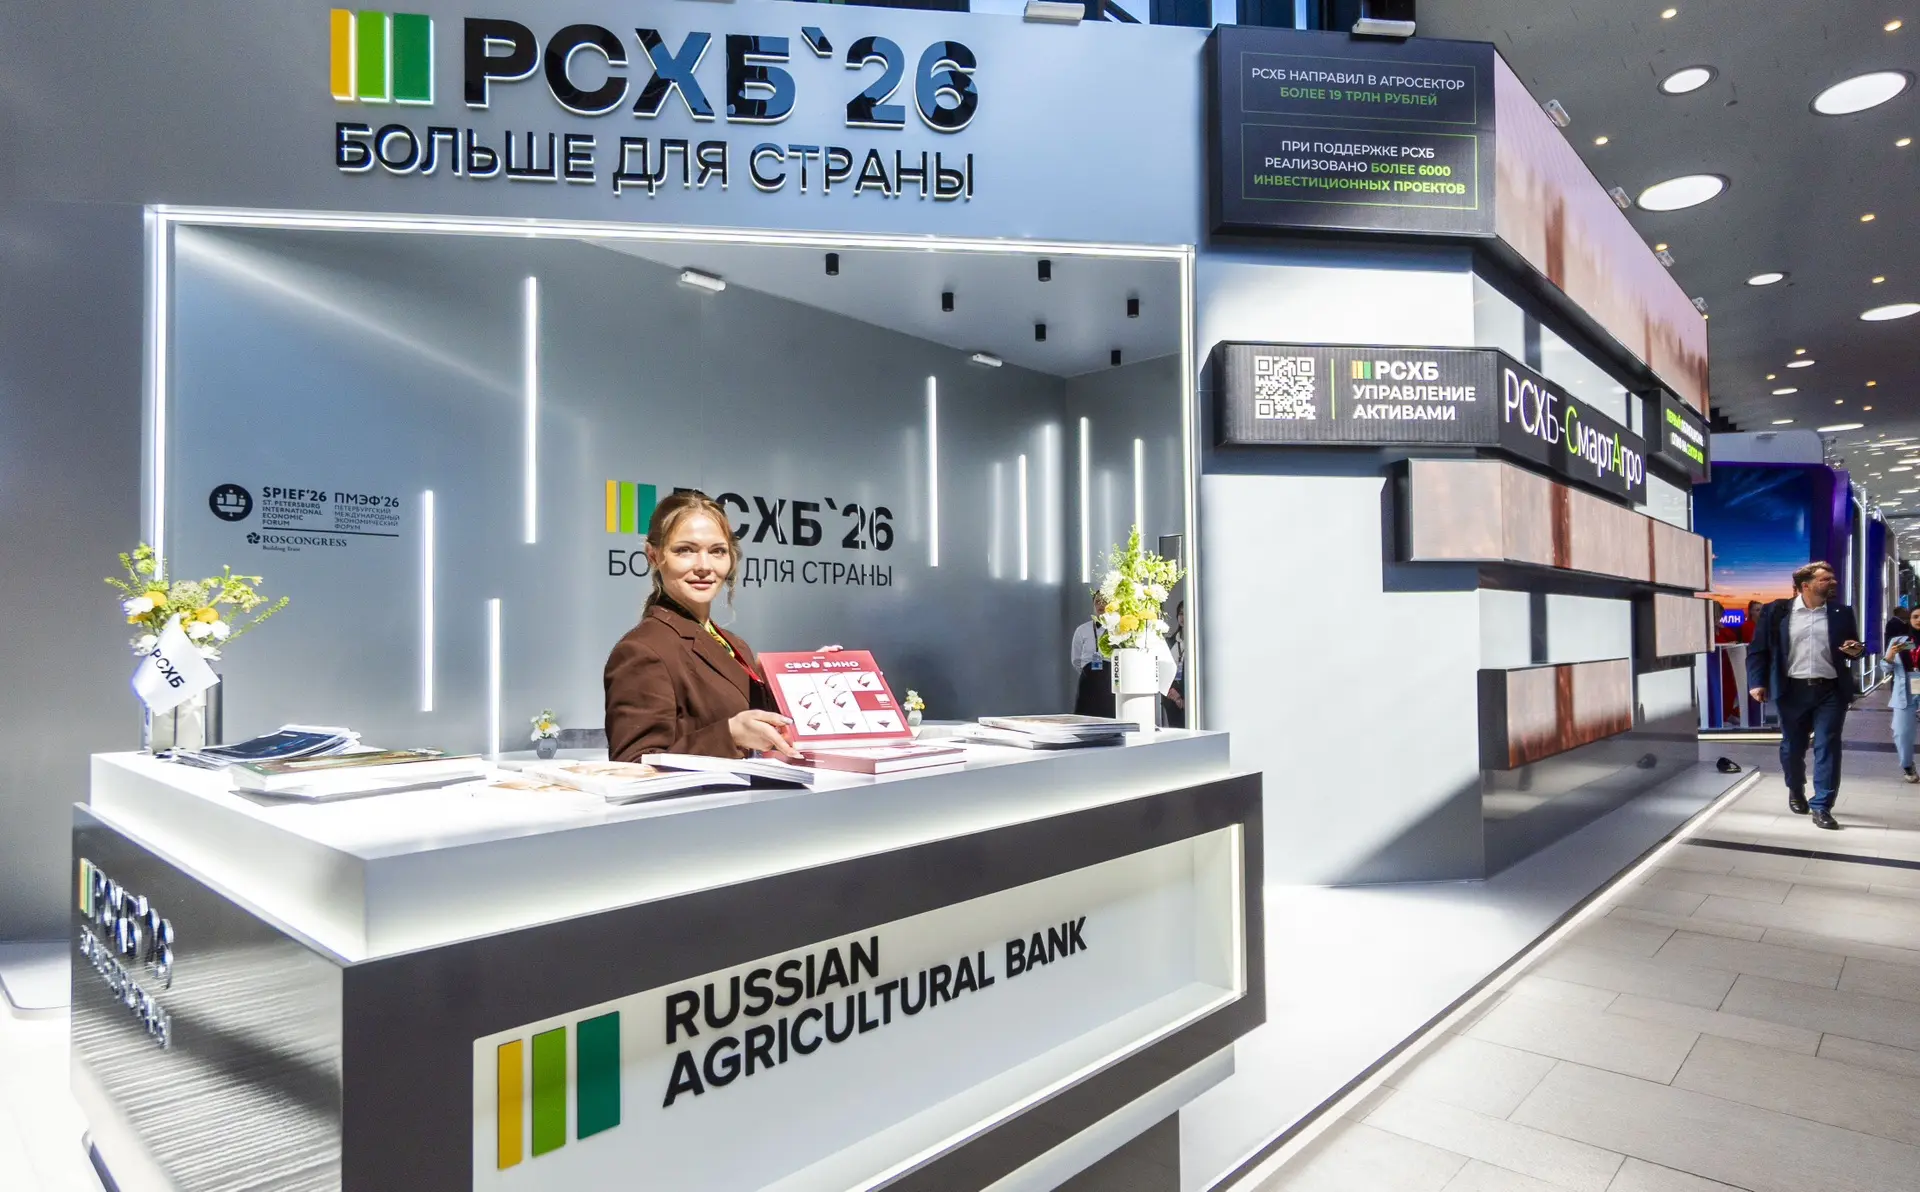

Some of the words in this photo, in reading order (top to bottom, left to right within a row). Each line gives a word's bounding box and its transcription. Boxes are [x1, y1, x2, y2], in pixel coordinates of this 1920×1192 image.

[1252, 68, 1286, 80] РСХБ
[1290, 71, 1364, 85] НАПРАВИЛ
[1368, 74, 1377, 85] В
[1380, 75, 1465, 91] АГРОСЕКТОР
[1280, 87, 1325, 100] БОЛЕЕ
[1329, 90, 1342, 100] 19
[1346, 91, 1381, 103] ТРЛН
[1385, 92, 1437, 106] РУБЛЕЙ
[1282, 141, 1310, 152] ПРИ
[1314, 142, 1398, 157] ПОДДЕРЖКЕ
[1401, 147, 1435, 159] РСХБ
[335, 121, 596, 182] БОЛЬШЕ
[612, 135, 729, 195] ДЛЯ
[749, 142, 974, 200] СТРАНЫ
[1265, 157, 1368, 172] РЕАЛИЗОВАНО
[1371, 163, 1415, 175] БОЛЕЕ
[1418, 165, 1451, 178] 6000
[1254, 174, 1390, 191] ИНВЕСТИЦИОННЫХ
[1393, 181, 1466, 194] ПРОЕКТОВ
[1375, 360, 1439, 381] РСХБ
[1352, 384, 1476, 402] УПРАВЛЕНИЕ
[1352, 404, 1456, 421] АКТИВАМИ
[1504, 367, 1642, 491] РСХБ-СмартАгро
[262, 486, 327, 502] SPIEF'26
[334, 492, 400, 508] ПМЭФ'26
[262, 506, 323, 516] INTERNATIONAL
[274, 500, 321, 509] PETERSBURG
[262, 512, 304, 521] ECONOMIC
[262, 535, 347, 547] ROSCONGRESS
[743, 557, 794, 588] ДЛЯ
[802, 561, 893, 587] СТРАНЫ
[150, 648, 185, 688] РСХБ
[665, 935, 880, 1045] RUSSIAN
[662, 956, 996, 1109] AGRICULTURAL
[1005, 916, 1087, 979] BANK
